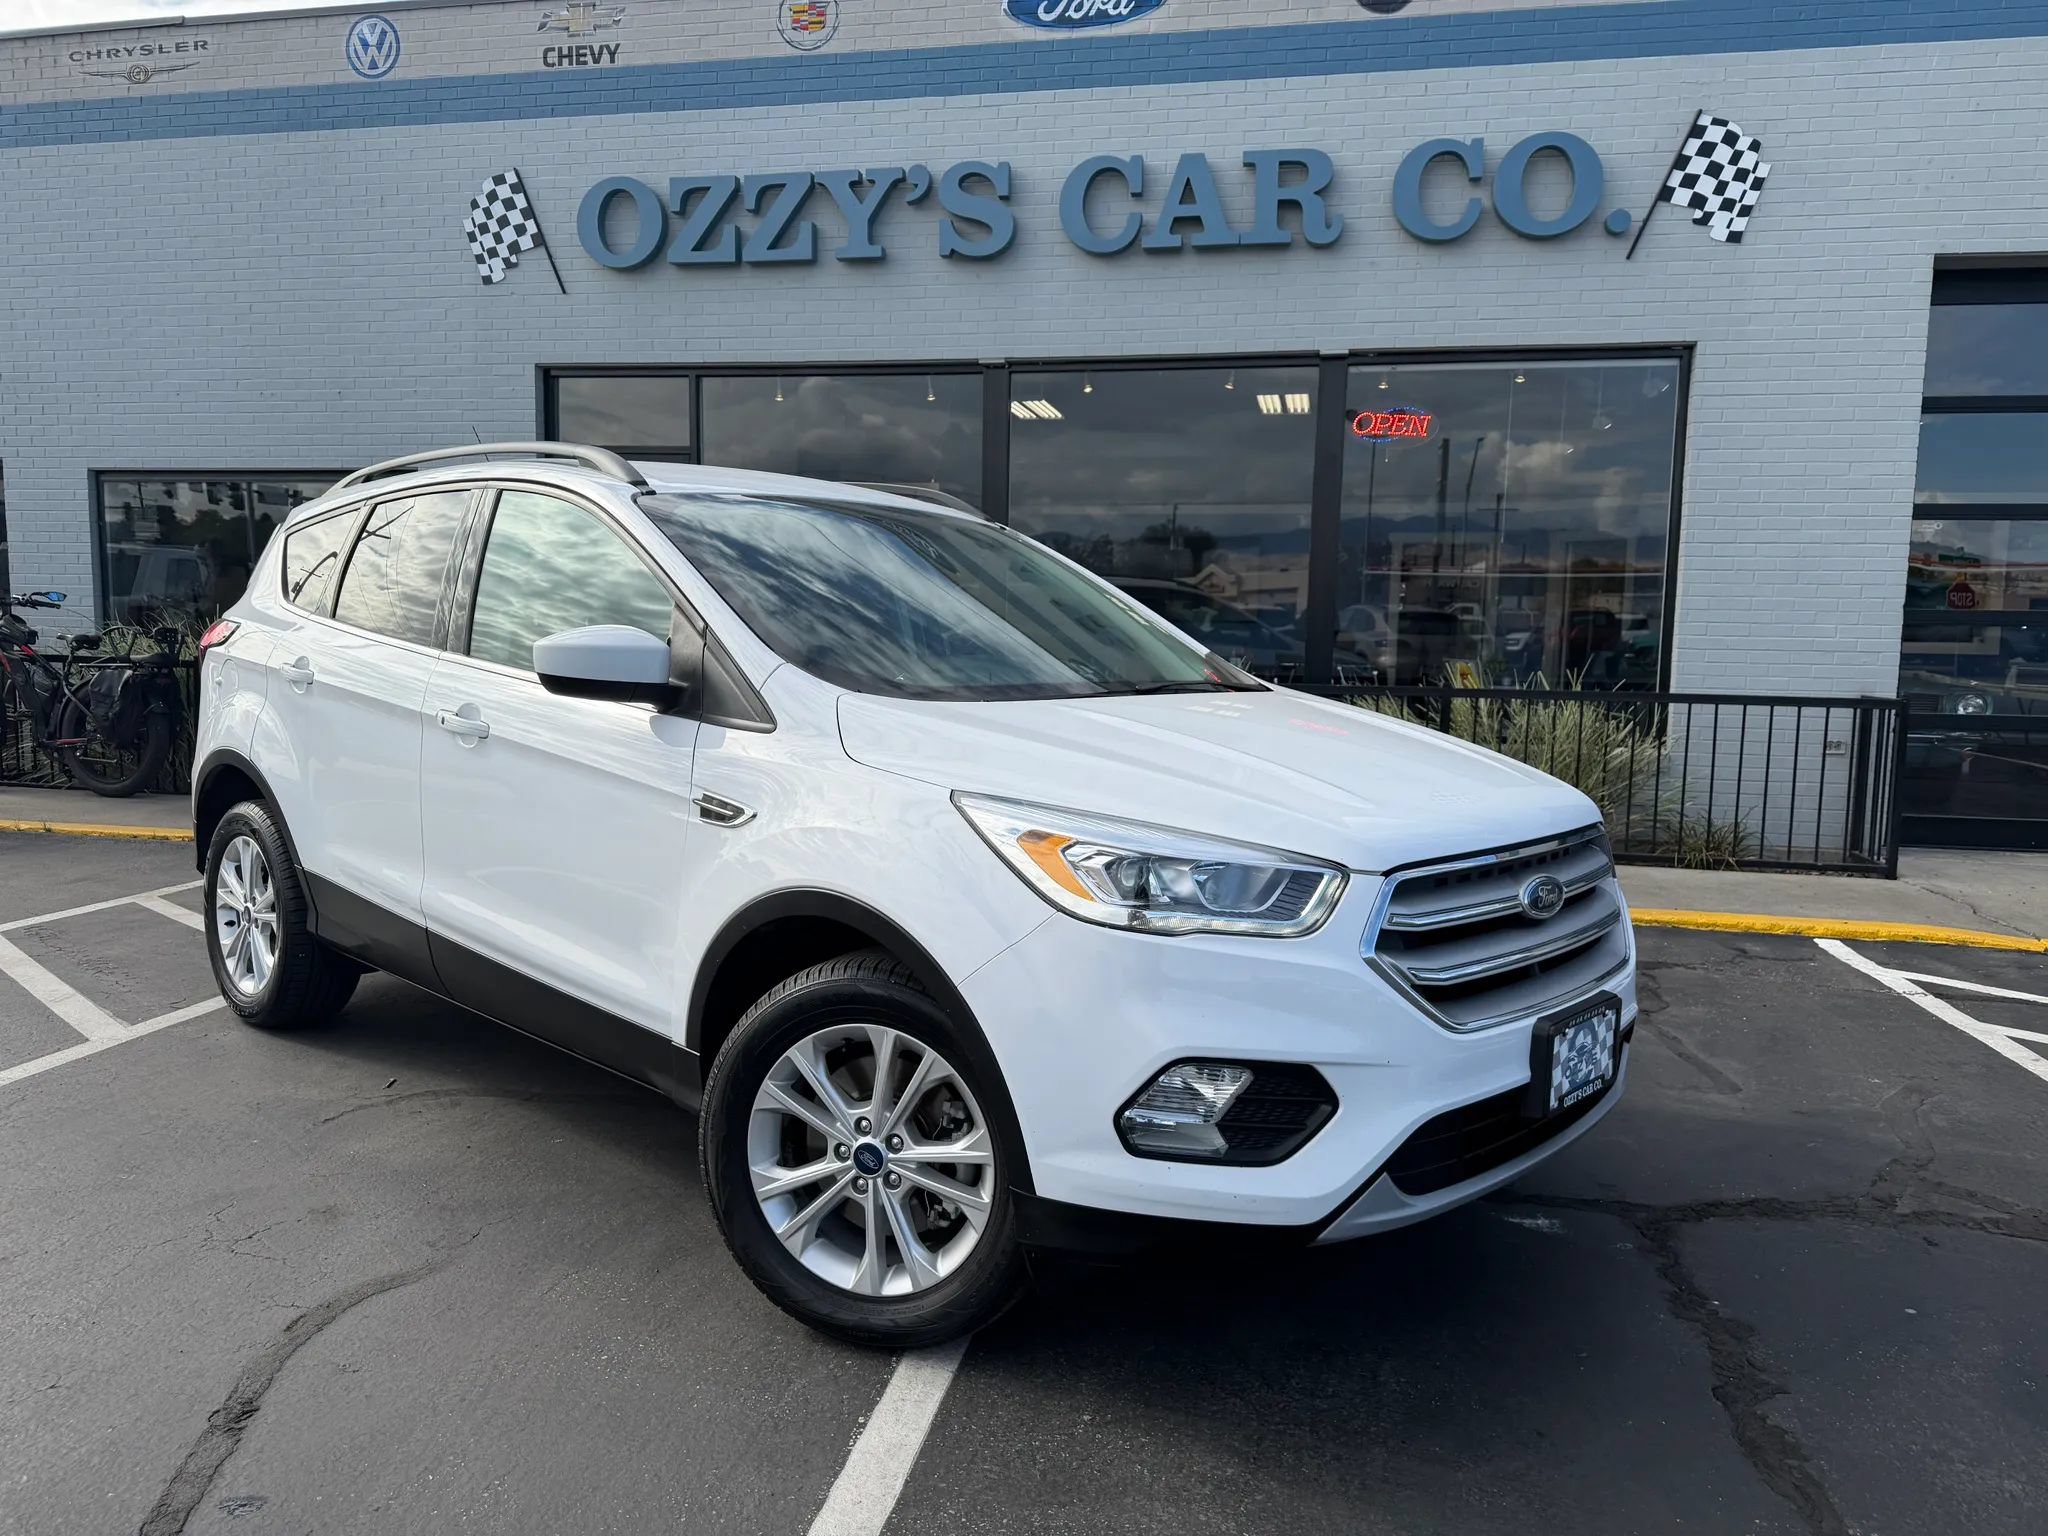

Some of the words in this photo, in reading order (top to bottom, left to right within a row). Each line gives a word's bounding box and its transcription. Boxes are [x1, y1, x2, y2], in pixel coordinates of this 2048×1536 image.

[68, 40, 209, 62] CHRYSLER
[542, 43, 621, 68] CHEVY
[577, 160, 1017, 270] OZZY'S
[1059, 148, 1345, 255] CAR
[1393, 131, 1632, 243] CO.
[1352, 411, 1431, 437] OPEN
[1537, 885, 1559, 908] Ford
